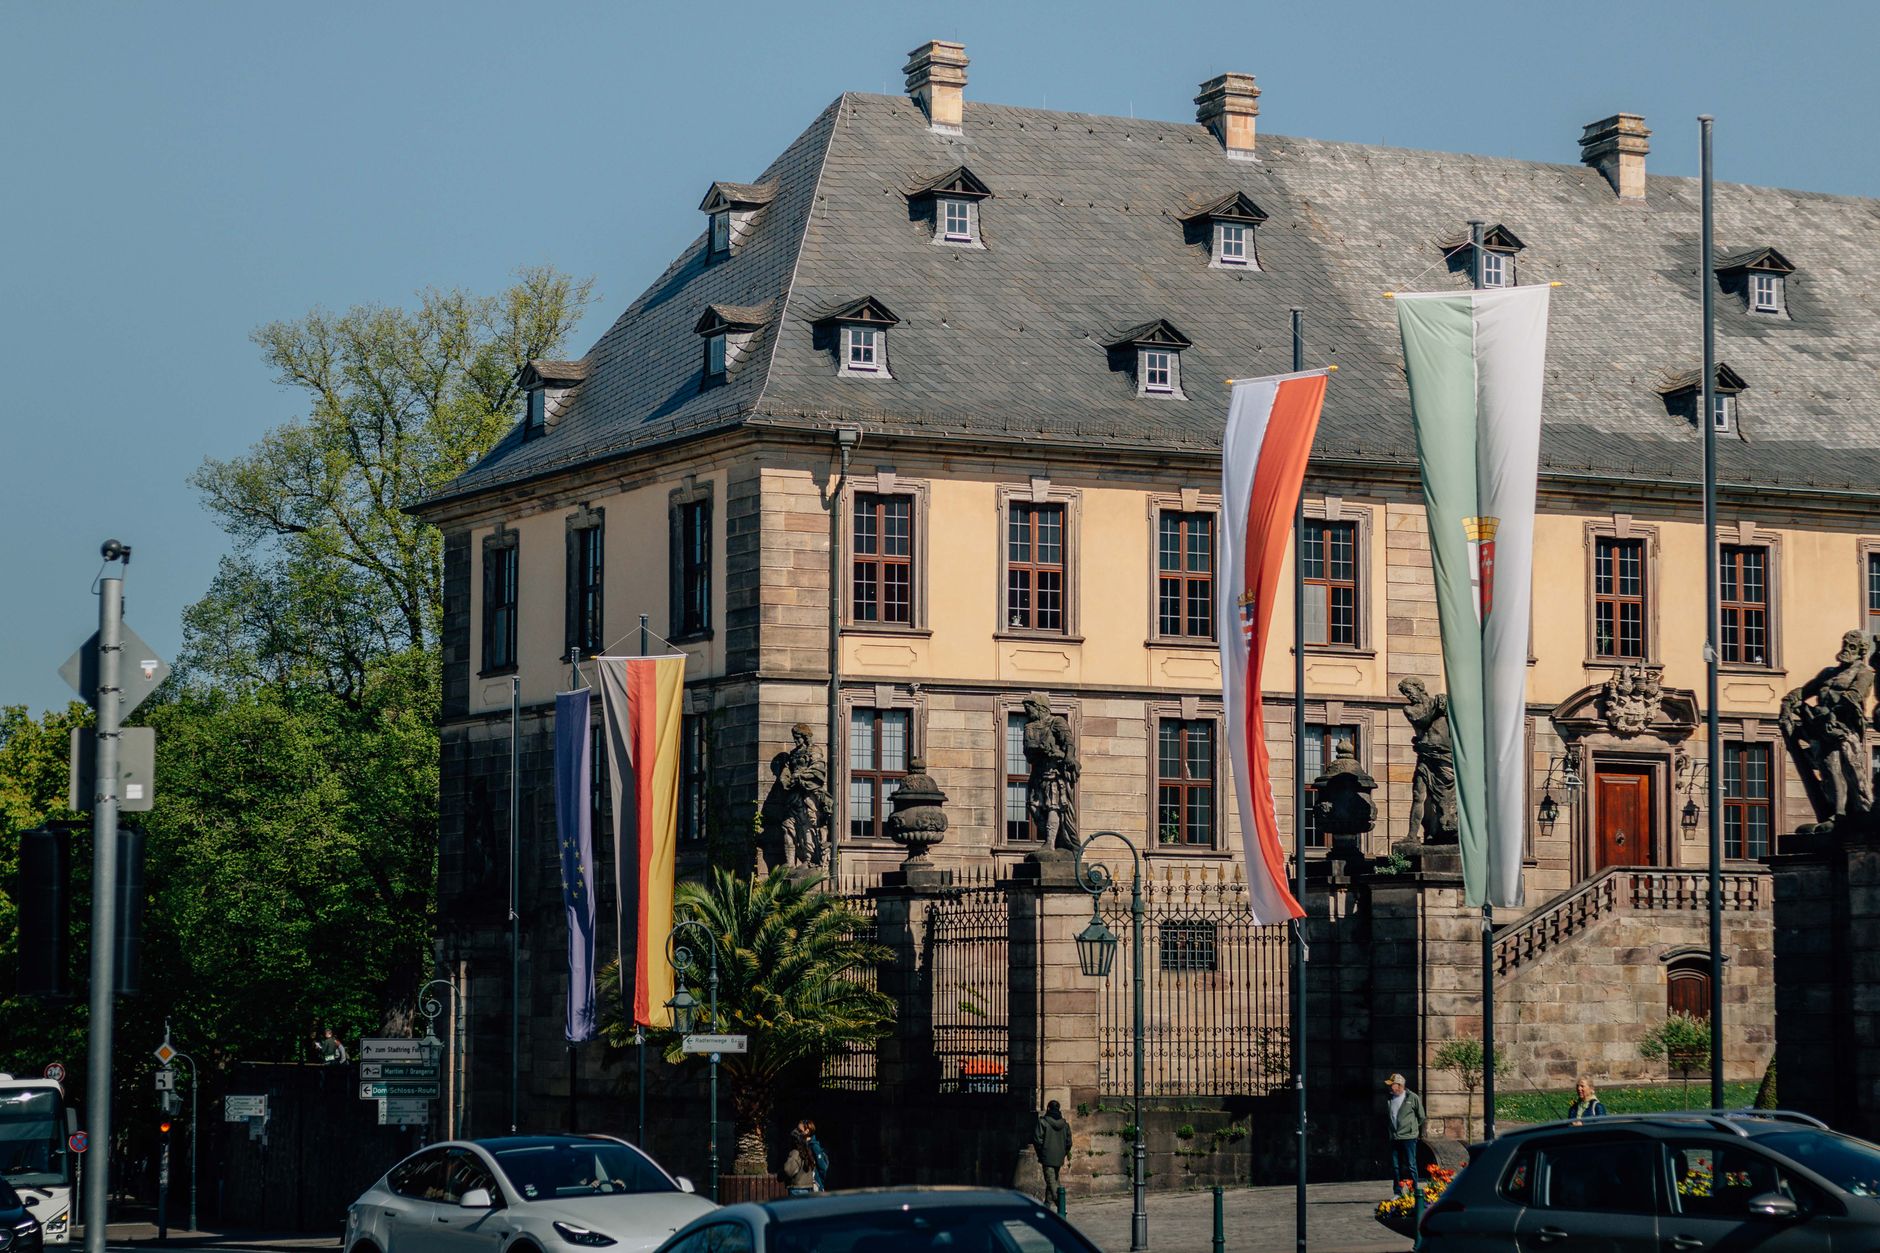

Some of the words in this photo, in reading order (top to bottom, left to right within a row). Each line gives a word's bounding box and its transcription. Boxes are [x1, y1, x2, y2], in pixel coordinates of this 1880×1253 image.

[387, 1046, 411, 1054] Stadtring
[384, 1067, 404, 1075] Maritim
[410, 1067, 434, 1076] Orangerie
